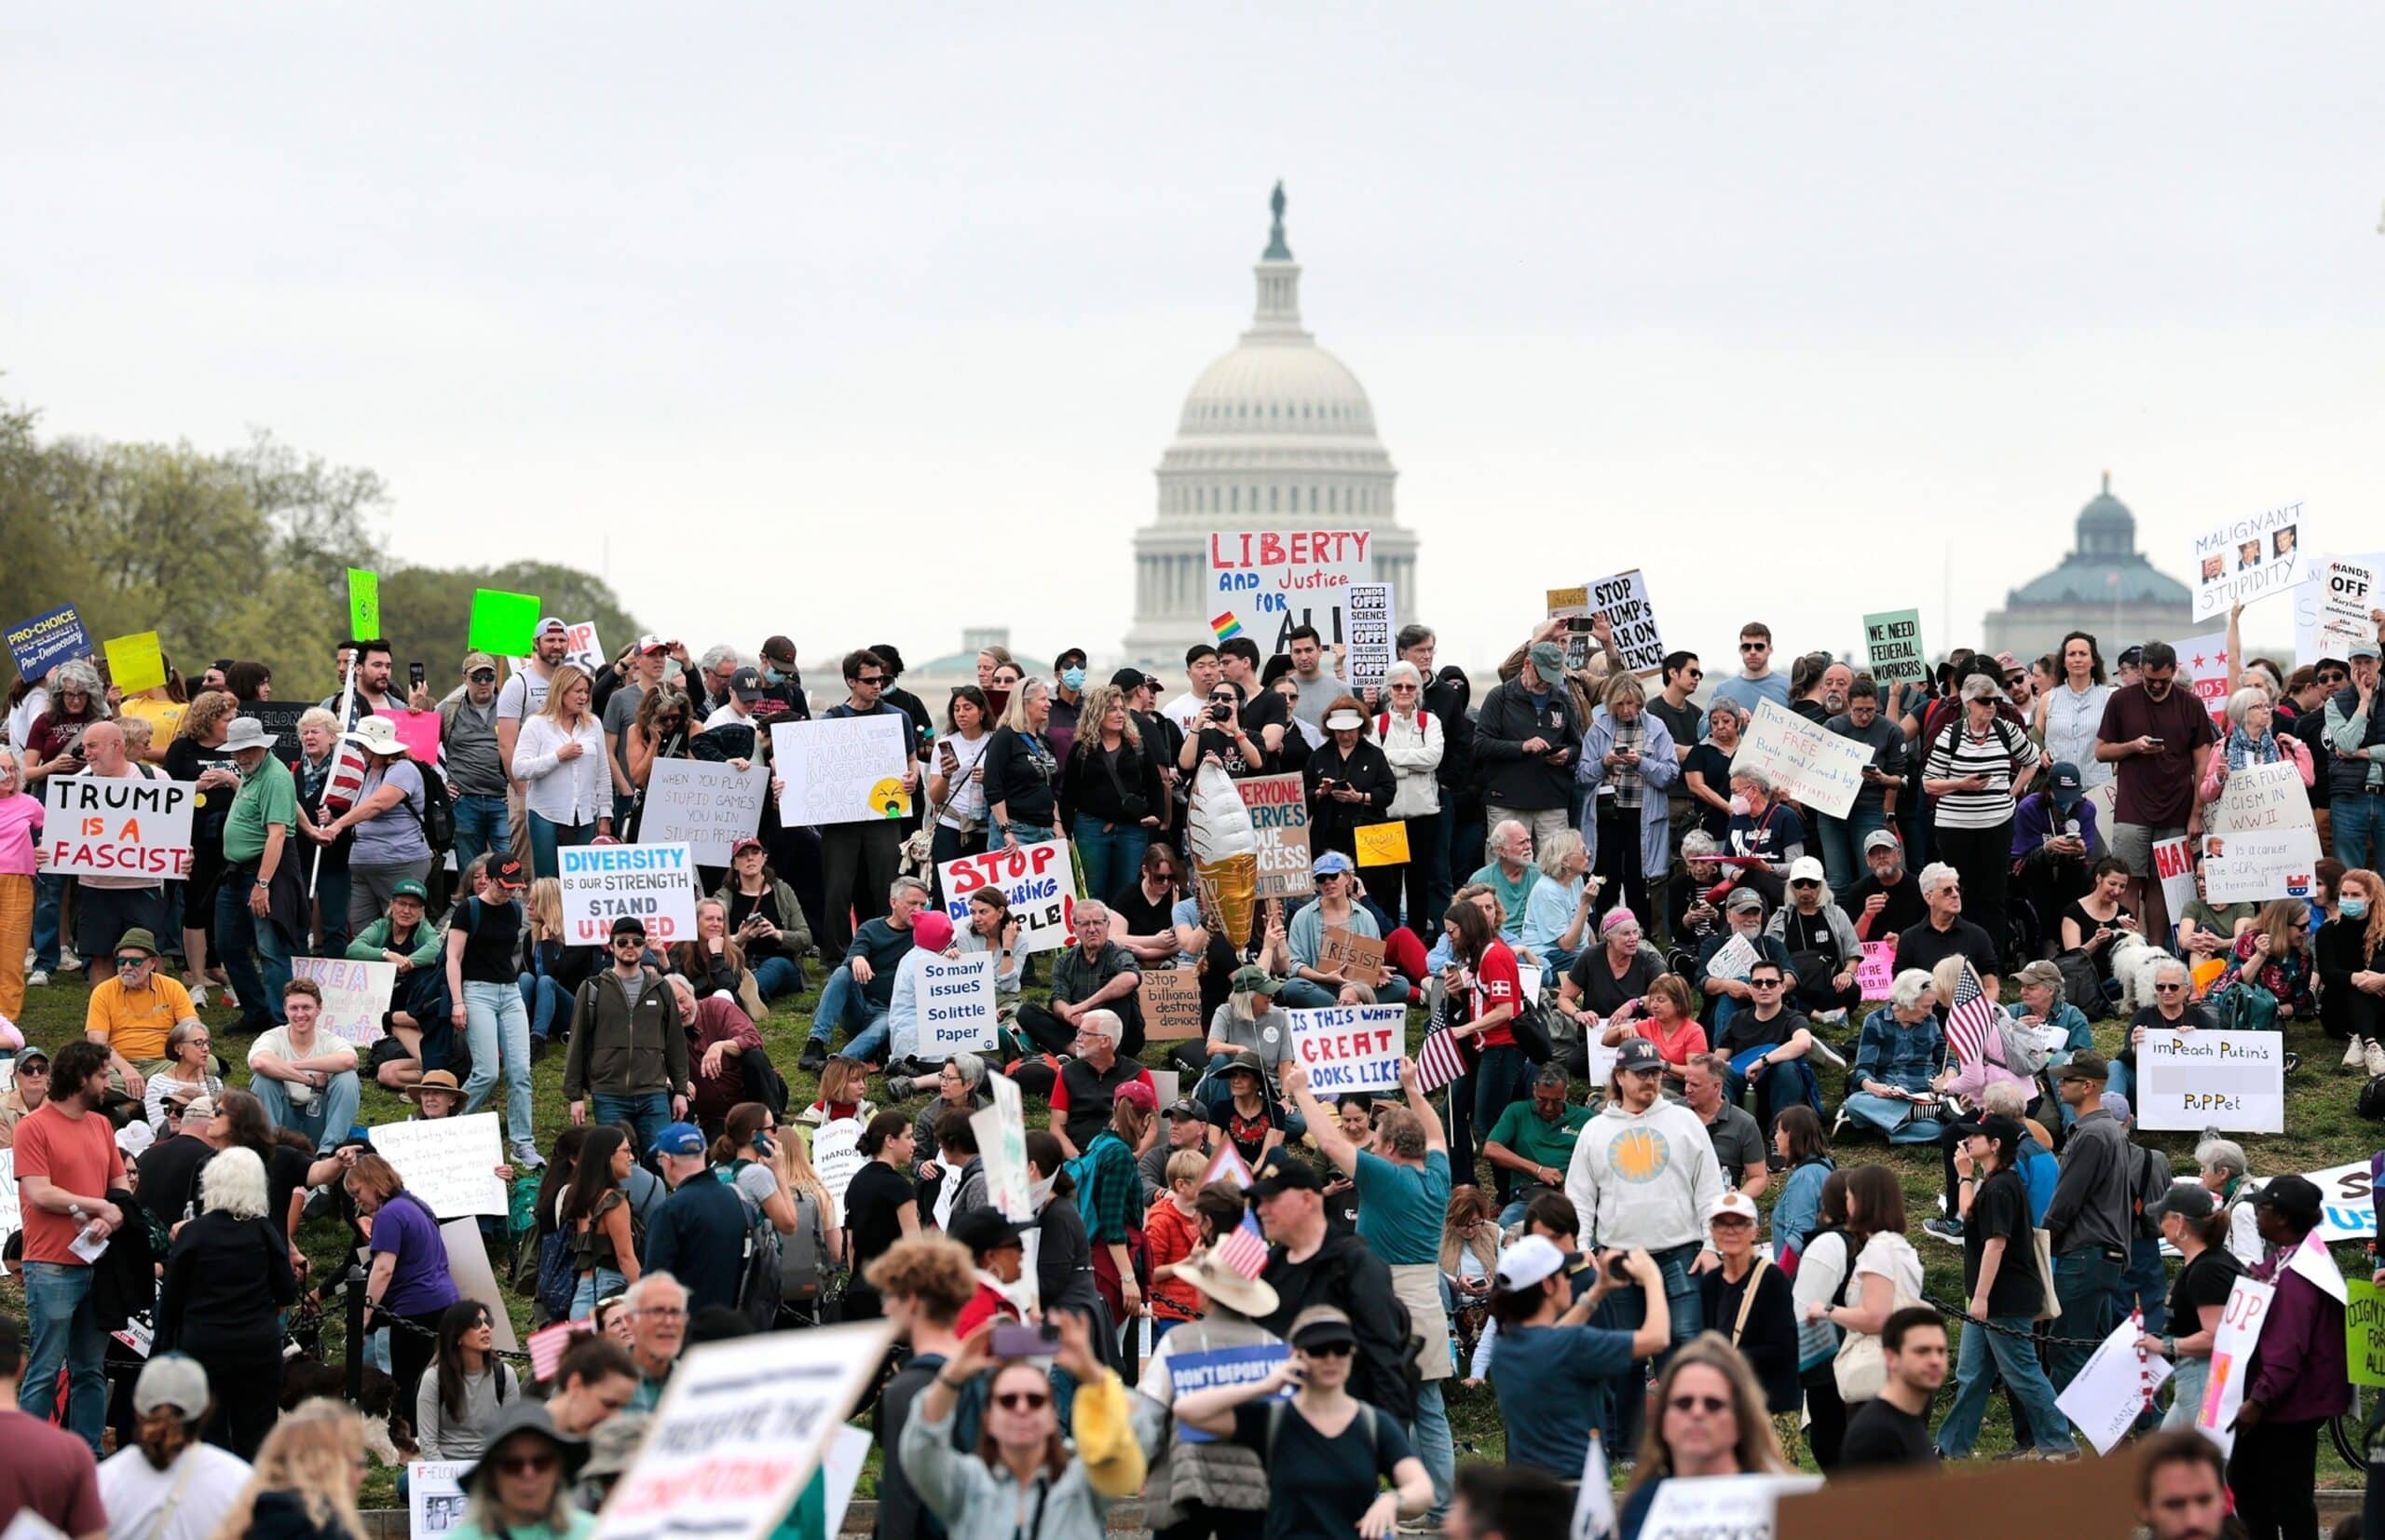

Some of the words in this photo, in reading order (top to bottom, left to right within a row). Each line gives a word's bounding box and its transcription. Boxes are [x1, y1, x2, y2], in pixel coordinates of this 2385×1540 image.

[2196, 502, 2303, 555] MALIGNANT
[1211, 531, 1370, 569] LIBERTY
[1279, 568, 1349, 590] Justice
[2333, 563, 2369, 579] HANDS
[1352, 588, 1384, 596] HANDS
[2201, 554, 2296, 610] STUPIDITY
[2331, 577, 2368, 596] OFF
[1256, 593, 1288, 612] FOR
[1352, 596, 1386, 608] OFF!
[1595, 579, 1631, 606] STOP
[2325, 606, 2368, 620] understands
[2332, 596, 2365, 610] Maryland
[1351, 611, 1387, 620] SCIENCE
[7, 609, 76, 646] PRO-CHOICE
[1354, 623, 1386, 632] HANDS
[1633, 620, 1657, 644] ON
[1868, 625, 1885, 641] WE
[1888, 621, 1915, 639] NEED
[1354, 632, 1387, 644] OFF!
[21, 631, 84, 672] Pro-Democracy
[1871, 641, 1916, 661] FEDERAL
[1873, 660, 1922, 681] WORKERS
[1761, 702, 1784, 724] This
[1789, 717, 1799, 730] is
[783, 722, 865, 749] MAGA
[1782, 730, 1819, 757] FREE
[807, 743, 889, 763] MAKING
[1788, 754, 1806, 768] and
[662, 773, 689, 784] WHEN
[700, 774, 717, 787] YOU
[722, 776, 753, 791] PLAY
[2259, 765, 2299, 787] FOUGHT
[54, 781, 184, 814] TRUMP
[665, 790, 709, 806] STUPID
[2272, 788, 2285, 804] IN
[687, 809, 710, 821] YOU
[715, 811, 739, 823] WIN
[82, 817, 104, 837] IS
[118, 818, 140, 844] A
[53, 841, 186, 874] FASCIST
[564, 848, 685, 873] DIVERSITY
[948, 846, 1056, 893] STOP
[564, 879, 575, 890] IS
[579, 878, 602, 889] OUR
[605, 872, 688, 891] STRENGTH
[1284, 870, 1311, 893] WHAT
[589, 897, 658, 917] STAND
[578, 917, 675, 940] UNED
[1329, 942, 1382, 969] RESIST
[925, 965, 945, 977] So
[1145, 972, 1178, 988] Stop
[928, 1008, 947, 1020] So
[949, 1004, 986, 1018] little
[1291, 1013, 1308, 1031] IS
[1314, 1009, 1355, 1029] THIS
[1361, 1009, 1404, 1021] WHAT
[1302, 1029, 1393, 1064] GREAT
[2220, 1042, 2269, 1059] Putin's
[1307, 1065, 1354, 1088] OOKS
[822, 1148, 859, 1163] HANDS
[1173, 1365, 1215, 1387] DON'T
